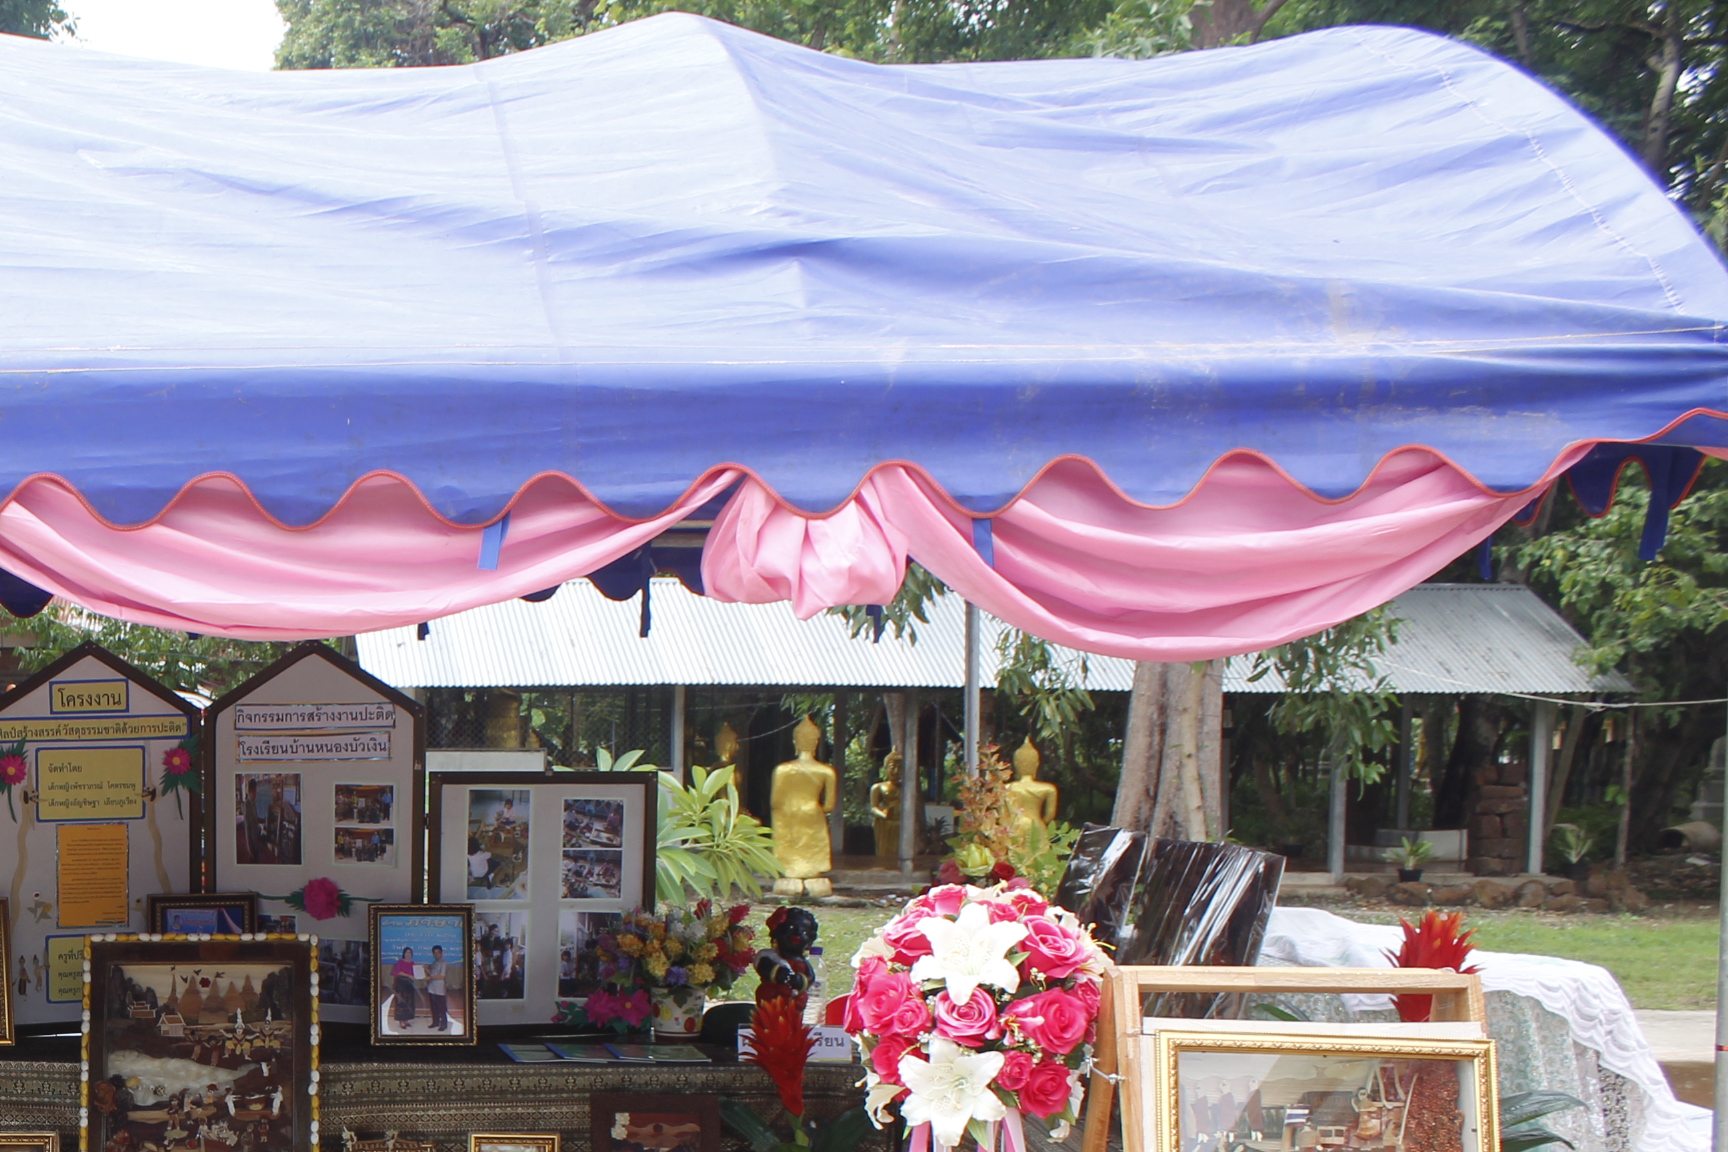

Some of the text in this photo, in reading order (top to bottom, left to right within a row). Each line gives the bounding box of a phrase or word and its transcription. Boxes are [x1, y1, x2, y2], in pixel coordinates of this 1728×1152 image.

[57, 687, 122, 708] โครงงาน
[236, 706, 395, 724] กิจกรรมการสร้างงานปะติด
[239, 737, 388, 756] โรงเรียนบ้านหนองบัวเงิน
[47, 762, 83, 773] จัดทำโดย
